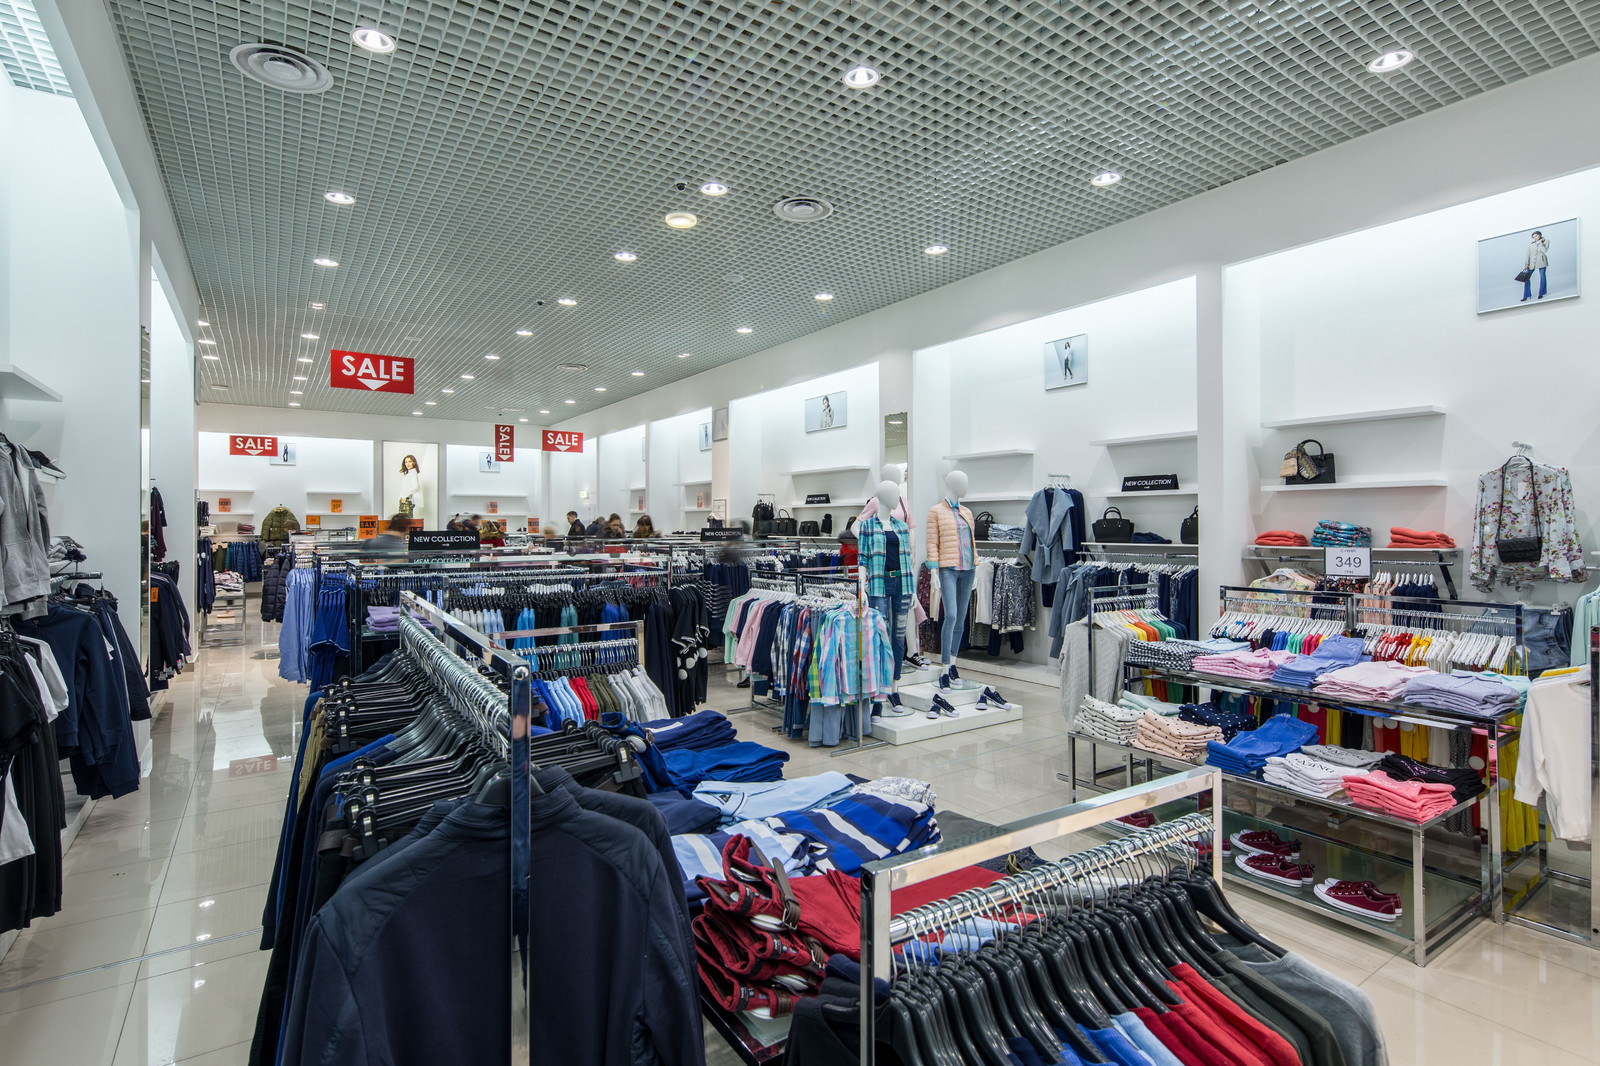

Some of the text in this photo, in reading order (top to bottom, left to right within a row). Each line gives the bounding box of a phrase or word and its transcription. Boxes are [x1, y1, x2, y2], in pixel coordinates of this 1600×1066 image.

[341, 355, 404, 381] SALE
[235, 437, 272, 450] SALE
[499, 426, 510, 454] SALE
[547, 432, 578, 446] SALE
[431, 535, 476, 543] COLLECTION
[1335, 556, 1362, 568] 349
